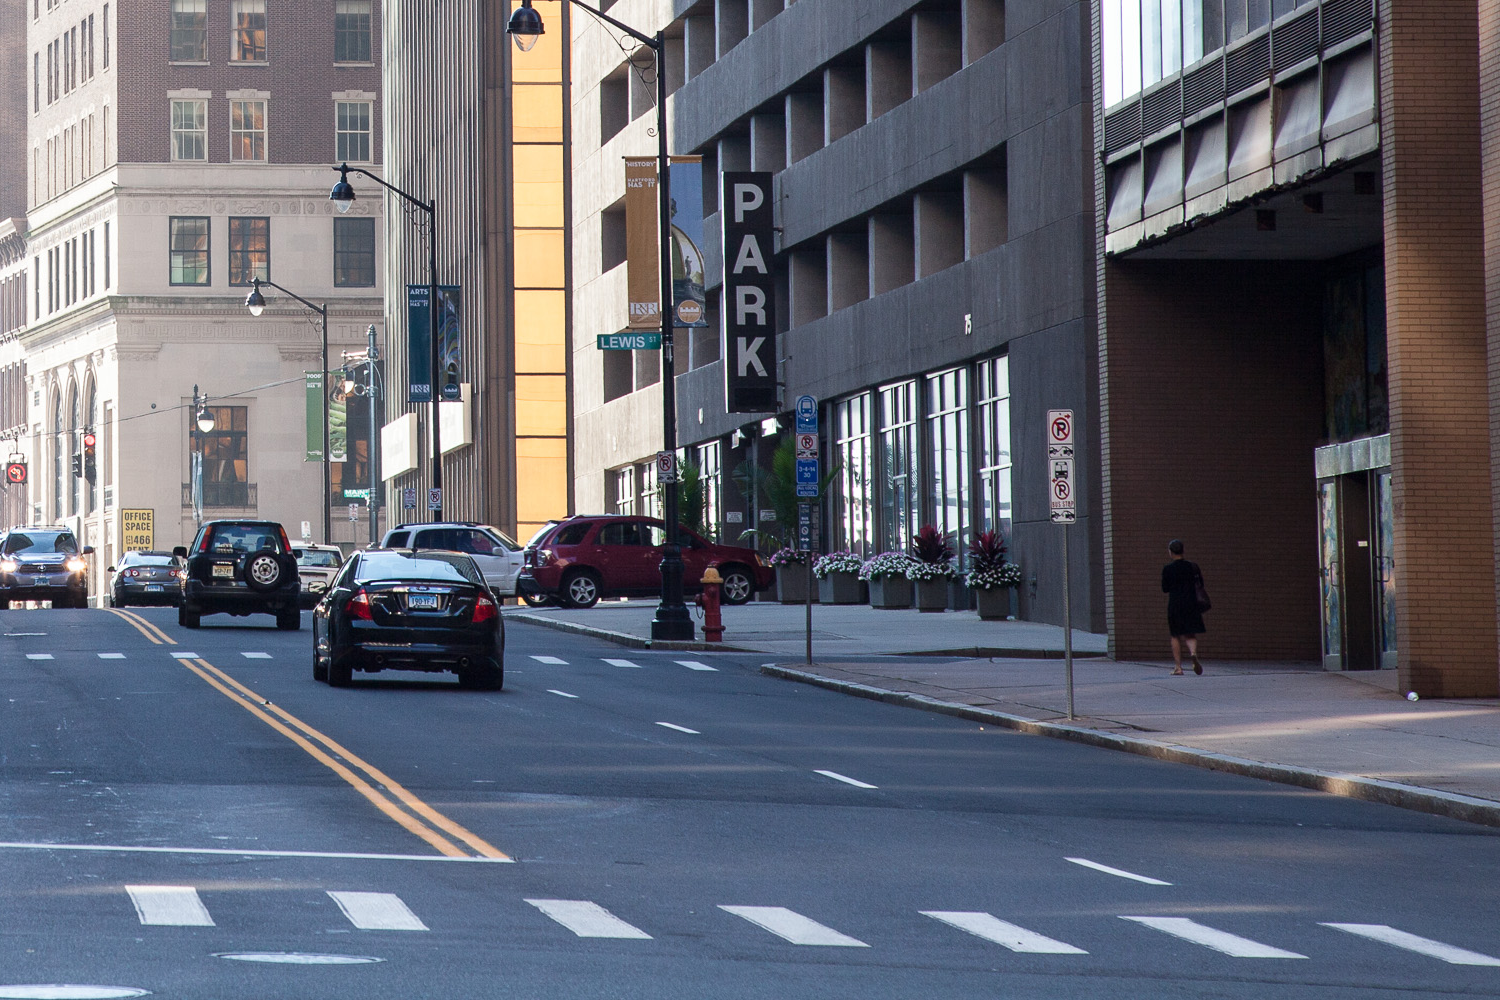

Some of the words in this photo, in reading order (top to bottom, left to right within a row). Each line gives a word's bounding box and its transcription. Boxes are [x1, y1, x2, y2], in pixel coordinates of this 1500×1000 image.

[732, 183, 769, 377] PARK
[600, 336, 646, 349] LEWIS
[124, 512, 152, 521] OFFICE
[125, 522, 151, 531] SPACE
